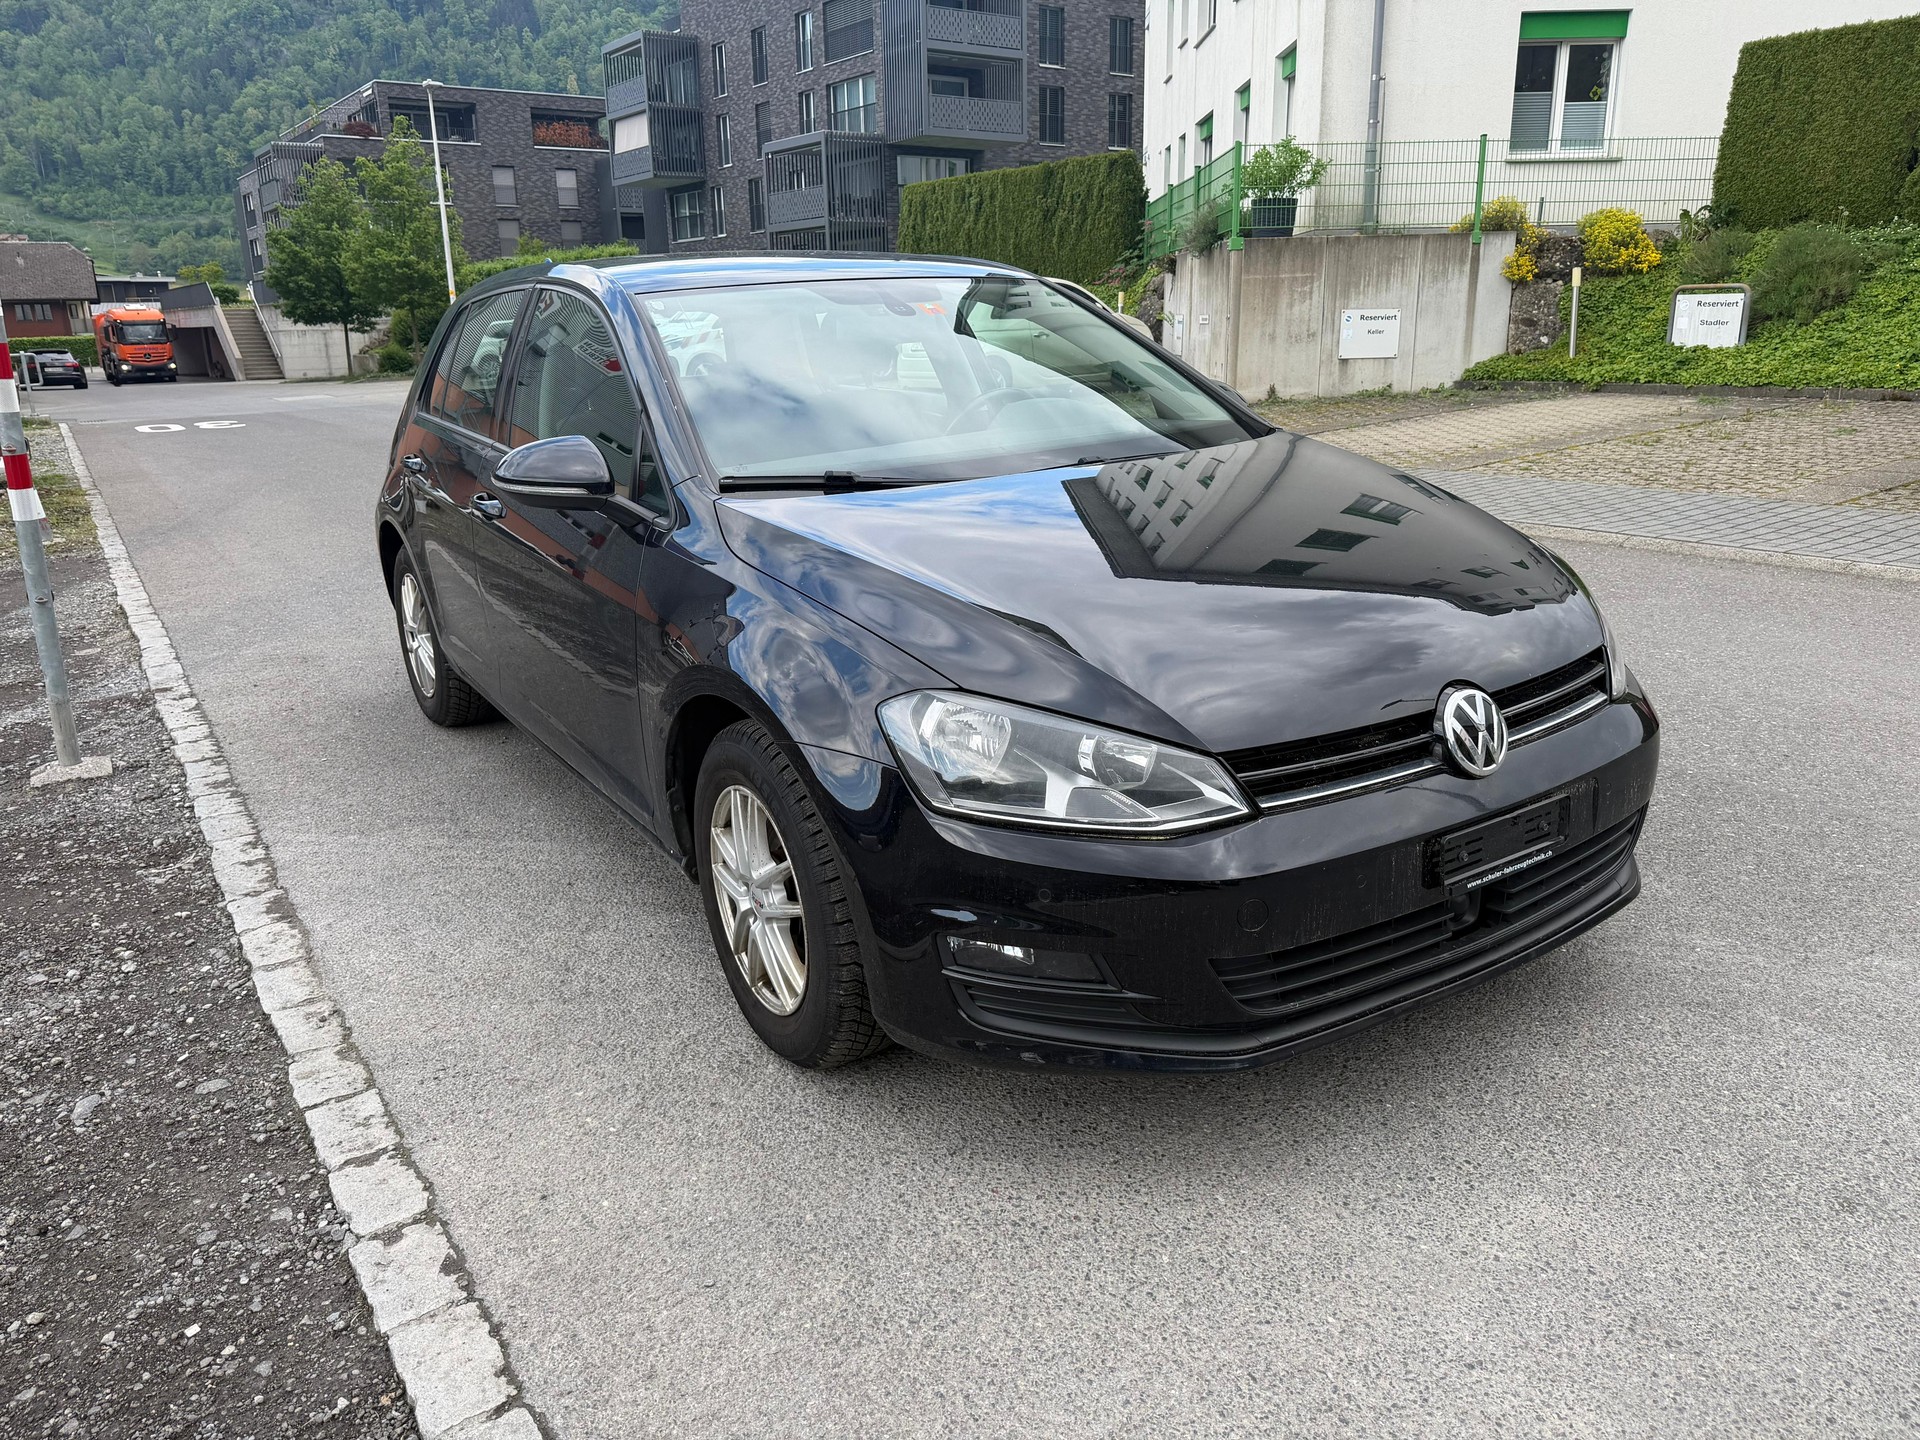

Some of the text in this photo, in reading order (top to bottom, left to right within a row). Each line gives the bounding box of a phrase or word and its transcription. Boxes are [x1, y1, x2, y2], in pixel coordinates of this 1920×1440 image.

[1696, 300, 1739, 308] Reserviert
[134, 420, 246, 433] 30
[1444, 689, 1508, 776] VW
[1466, 850, 1553, 889] www.schuler-fahrzeugtechnik.ch
